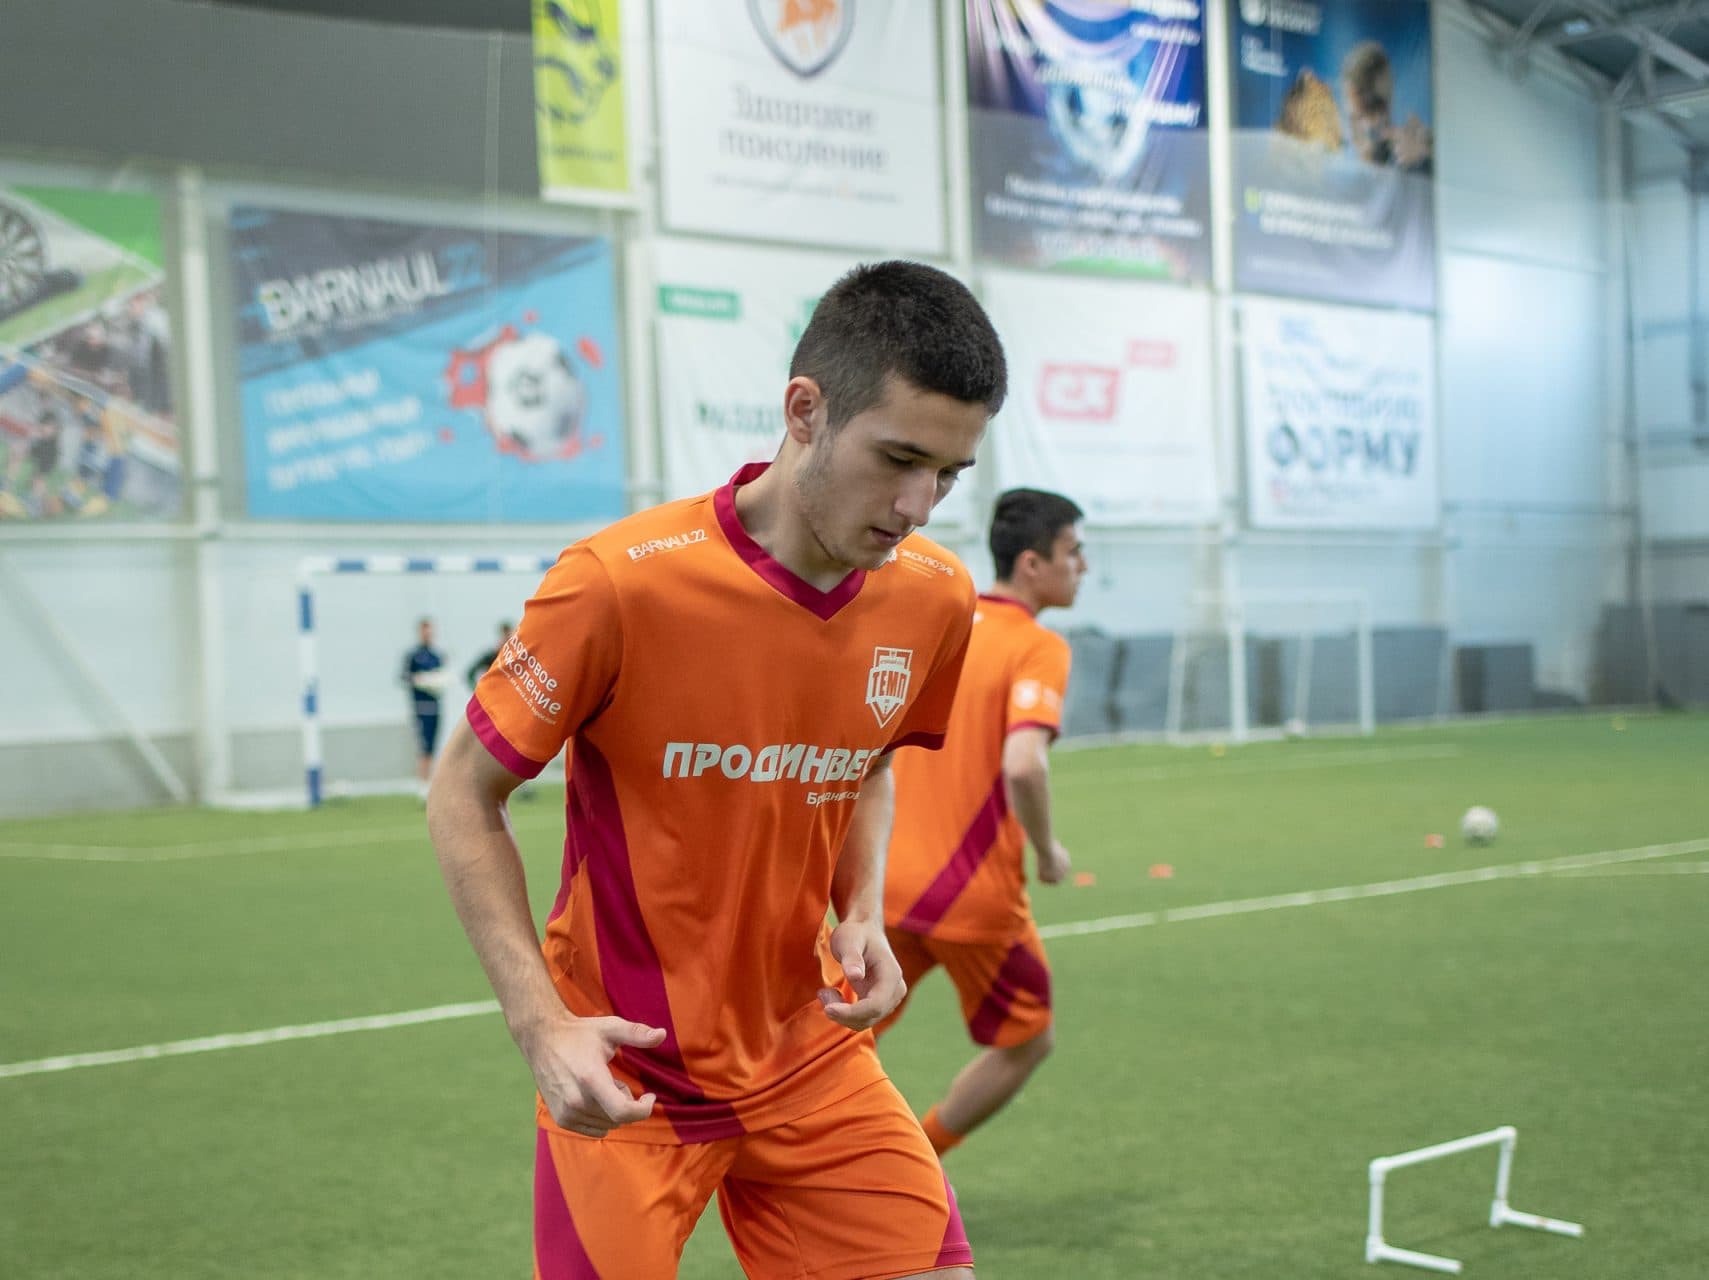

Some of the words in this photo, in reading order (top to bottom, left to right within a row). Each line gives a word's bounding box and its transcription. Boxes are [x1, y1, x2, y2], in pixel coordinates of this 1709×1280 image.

[627, 528, 708, 560] BARNAUL22
[510, 634, 558, 692] доровое
[871, 670, 908, 699] ТЕМП
